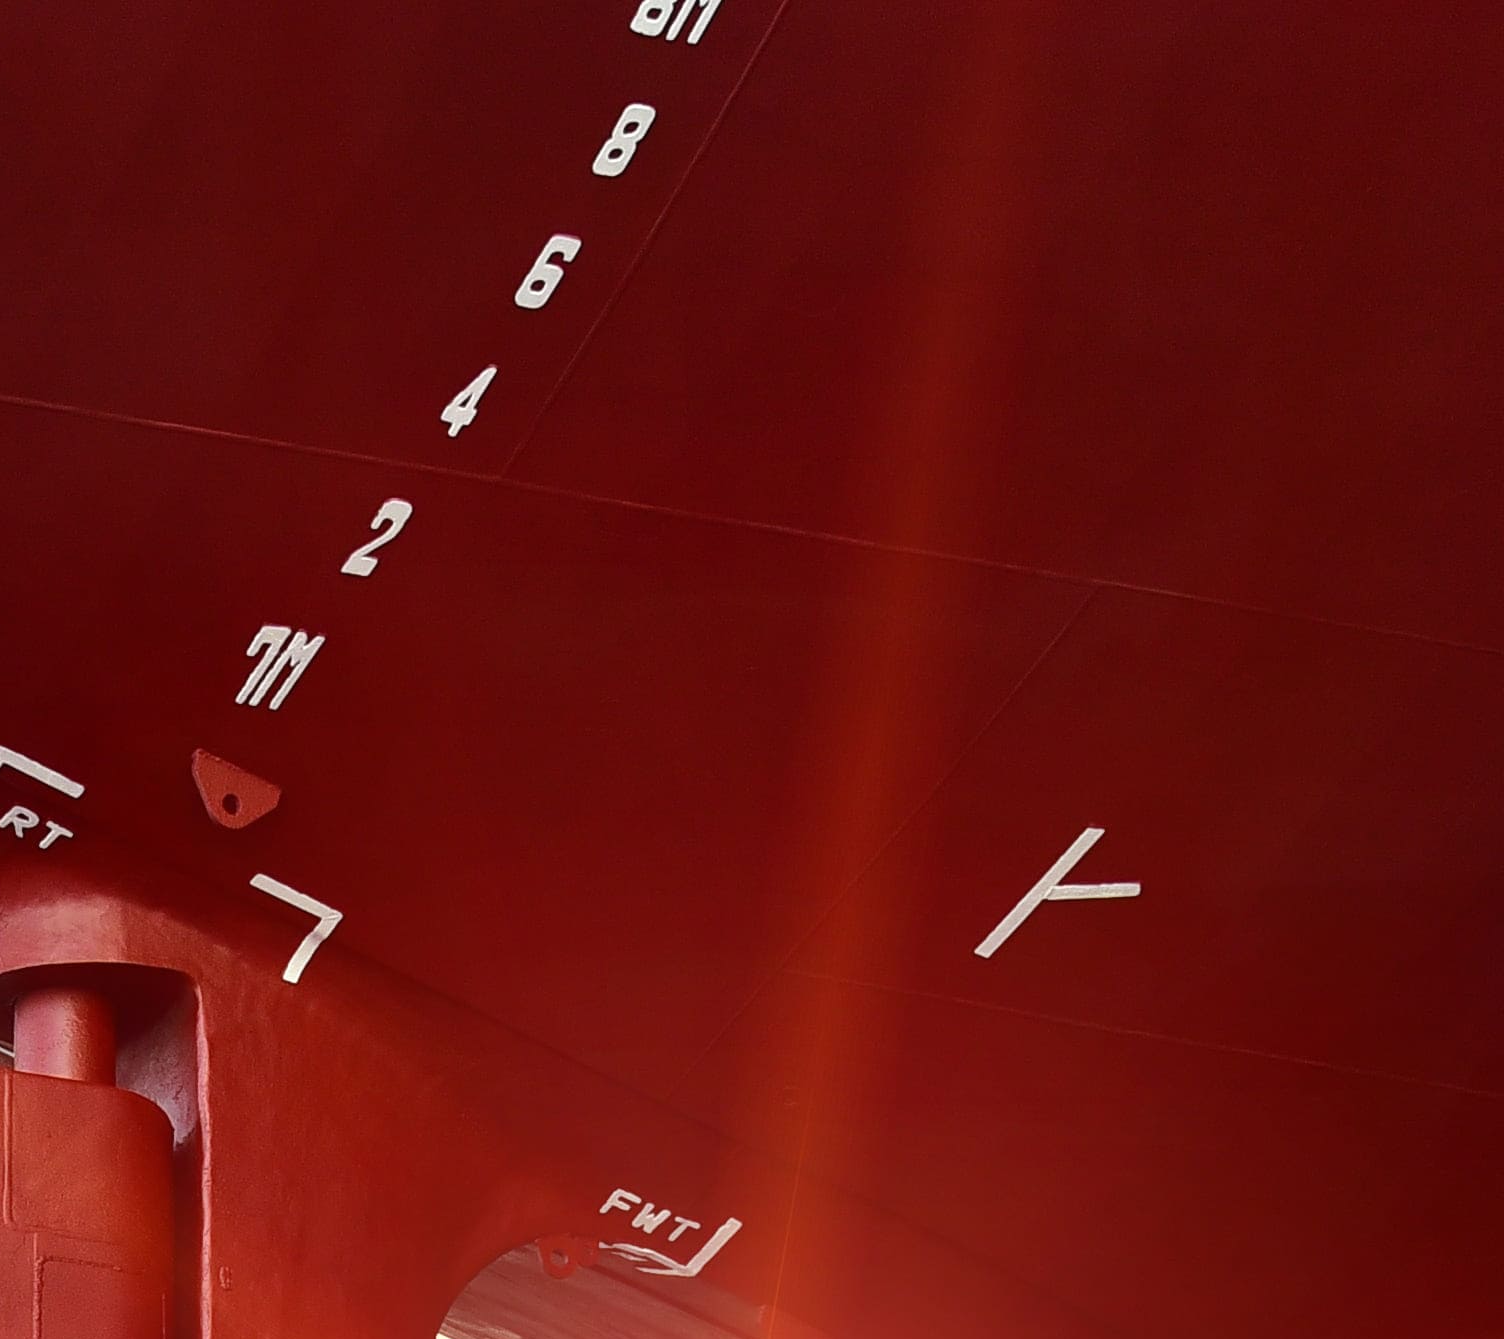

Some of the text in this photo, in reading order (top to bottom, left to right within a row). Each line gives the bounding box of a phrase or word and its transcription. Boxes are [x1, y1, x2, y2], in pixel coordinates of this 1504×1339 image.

[591, 103, 657, 177] 8
[514, 234, 582, 309] 6
[440, 365, 498, 438] 4
[340, 497, 413, 577] 2
[234, 624, 326, 711] 7M
[598, 1187, 702, 1243] FWT
